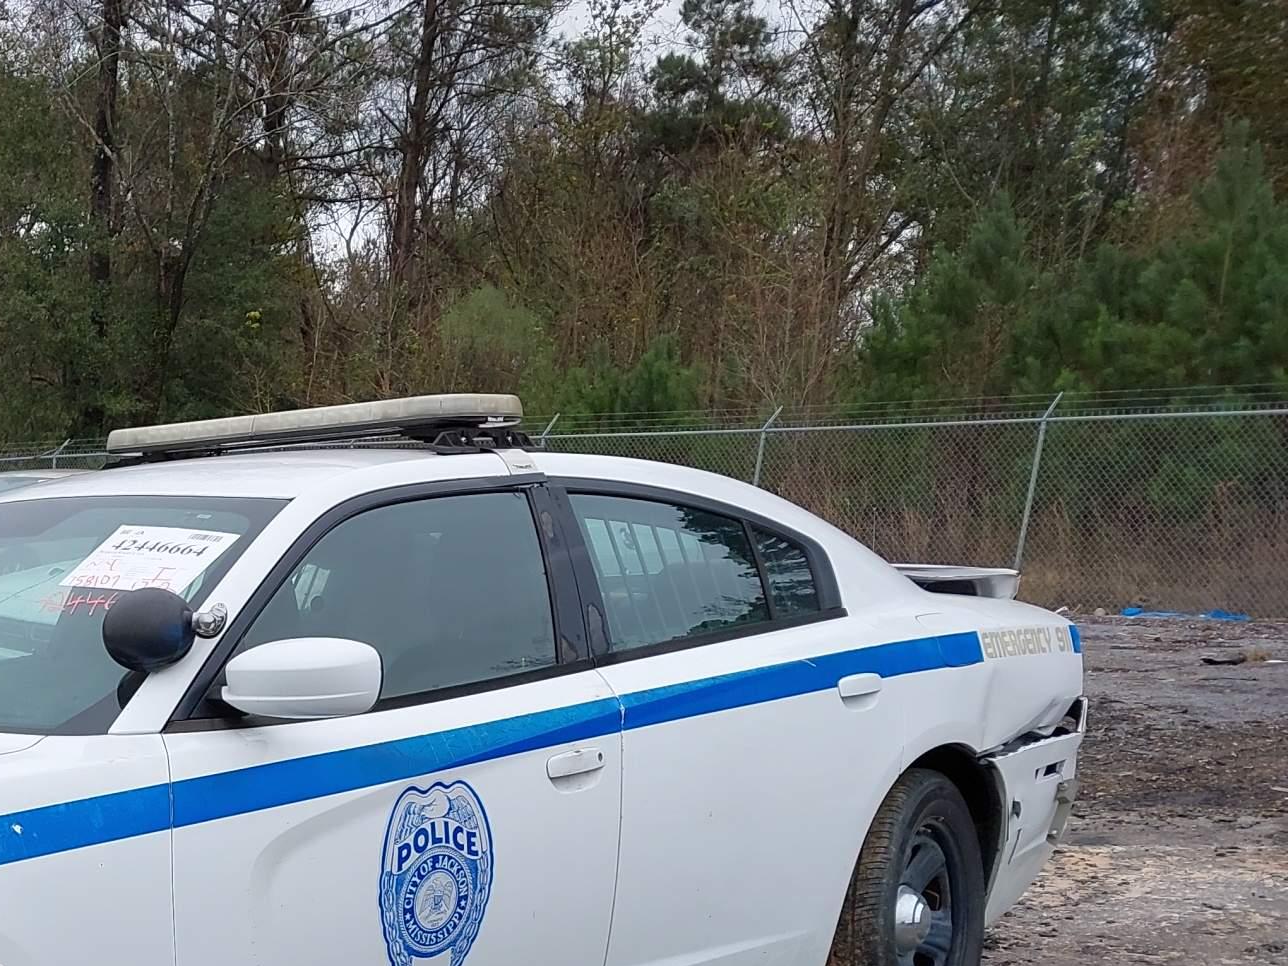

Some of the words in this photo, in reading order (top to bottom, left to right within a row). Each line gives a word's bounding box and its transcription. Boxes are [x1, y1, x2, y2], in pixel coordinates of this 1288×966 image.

[111, 539, 209, 557] 42446664
[982, 626, 1052, 658] EMERGENCY
[397, 820, 480, 873] POLICE
[404, 870, 421, 909] CITY
[419, 858, 434, 876] OF
[435, 855, 468, 897] JACKSON
[405, 907, 465, 945] MISSISSIPPI
